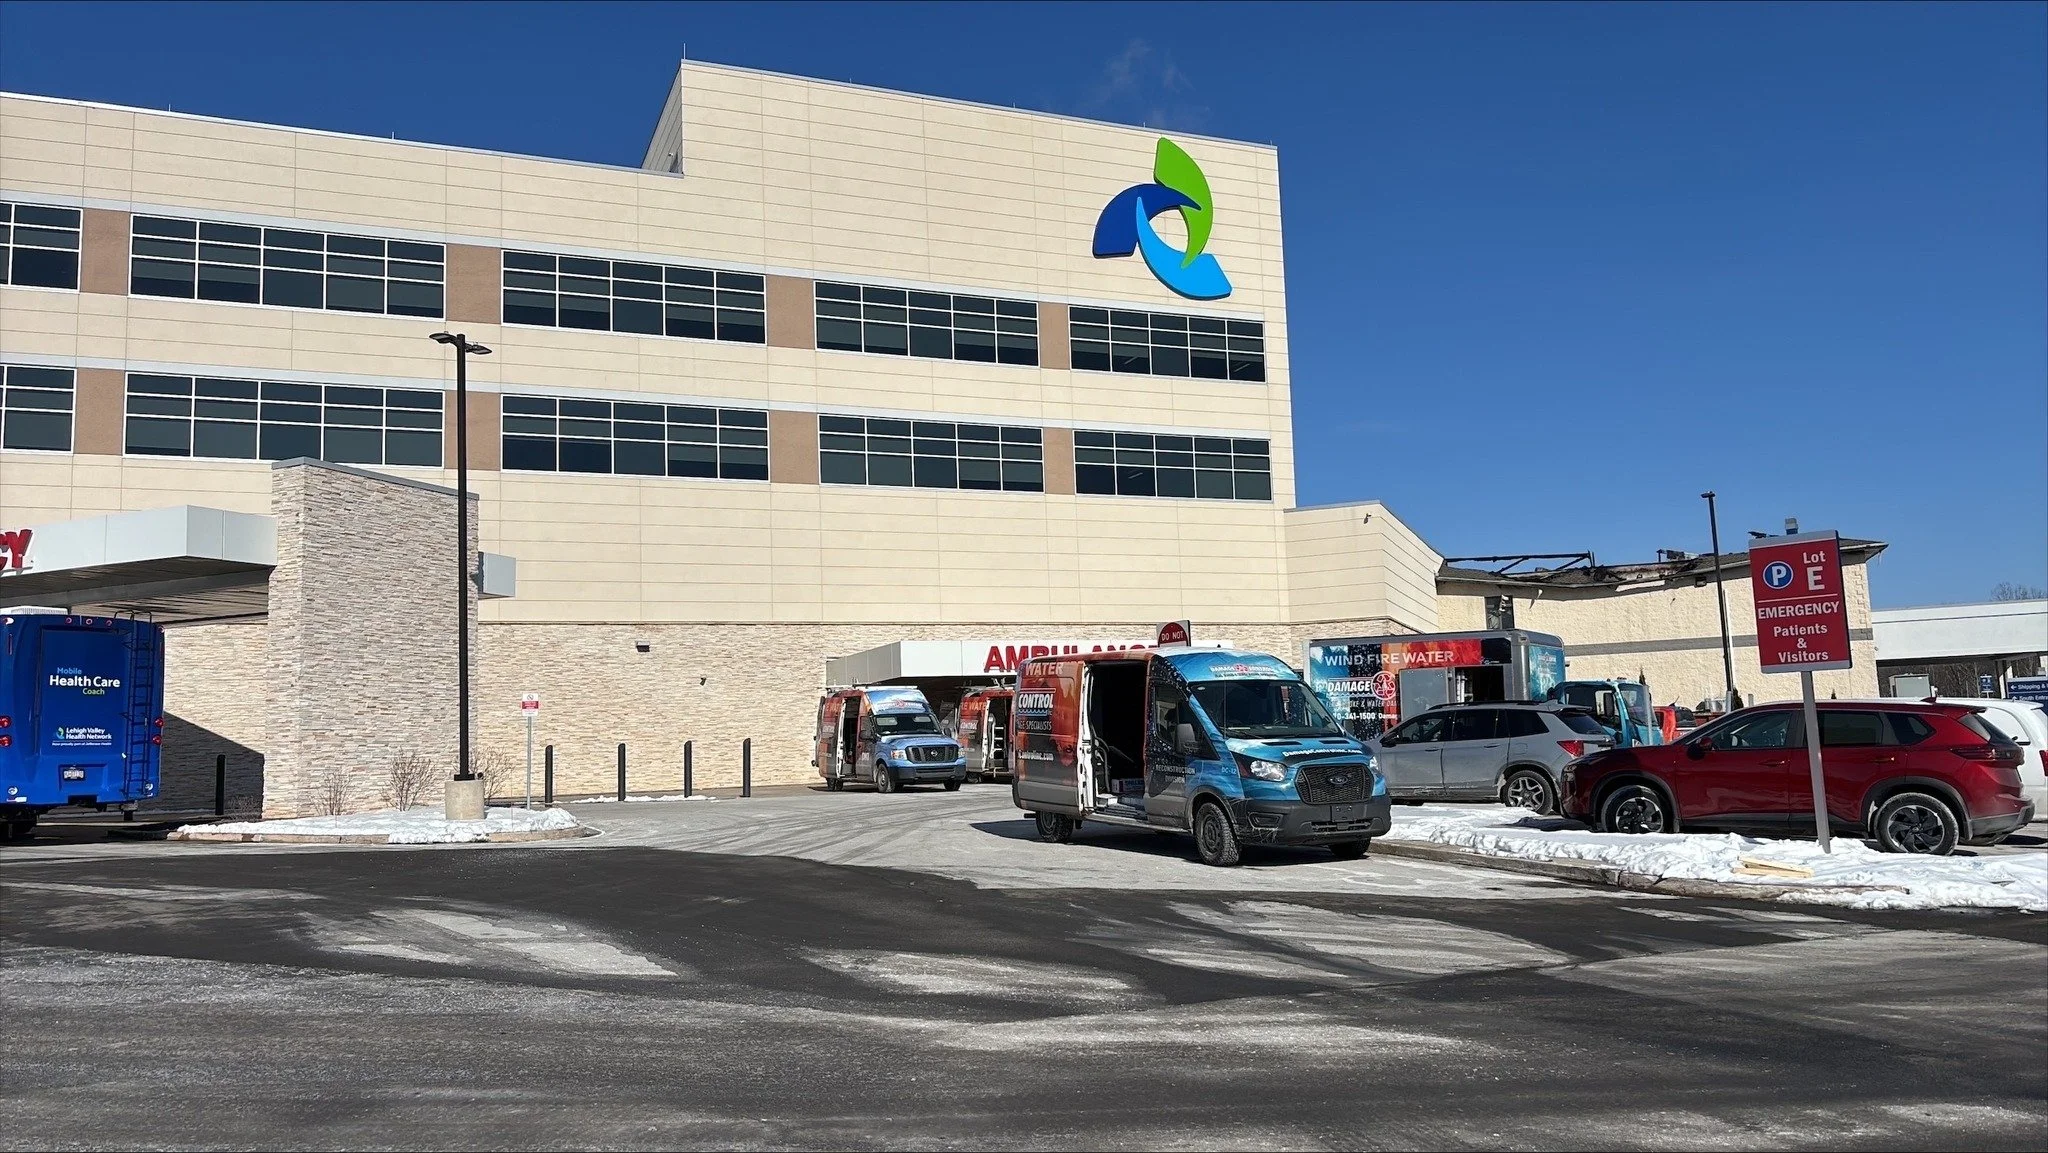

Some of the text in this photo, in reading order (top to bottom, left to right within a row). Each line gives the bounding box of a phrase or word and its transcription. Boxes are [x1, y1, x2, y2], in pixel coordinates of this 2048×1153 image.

[1803, 551, 1826, 564] Lot
[1771, 565, 1788, 586] P
[1806, 566, 1825, 591] E
[1757, 601, 1840, 620] EMERGENCY
[1161, 630, 1184, 641] DO NOT
[1773, 623, 1828, 637] Patients
[1796, 637, 1807, 649] &
[1324, 650, 1455, 667] WIND FIRE WATER
[1778, 651, 1829, 663] Visitors
[57, 667, 82, 675] Mobile
[1025, 661, 1064, 676] WATER
[49, 675, 121, 688] Health Care
[1327, 680, 1371, 692] DAMAGE
[1018, 693, 1054, 709] CONTROL
[66, 727, 106, 735] Lehigh Valley
